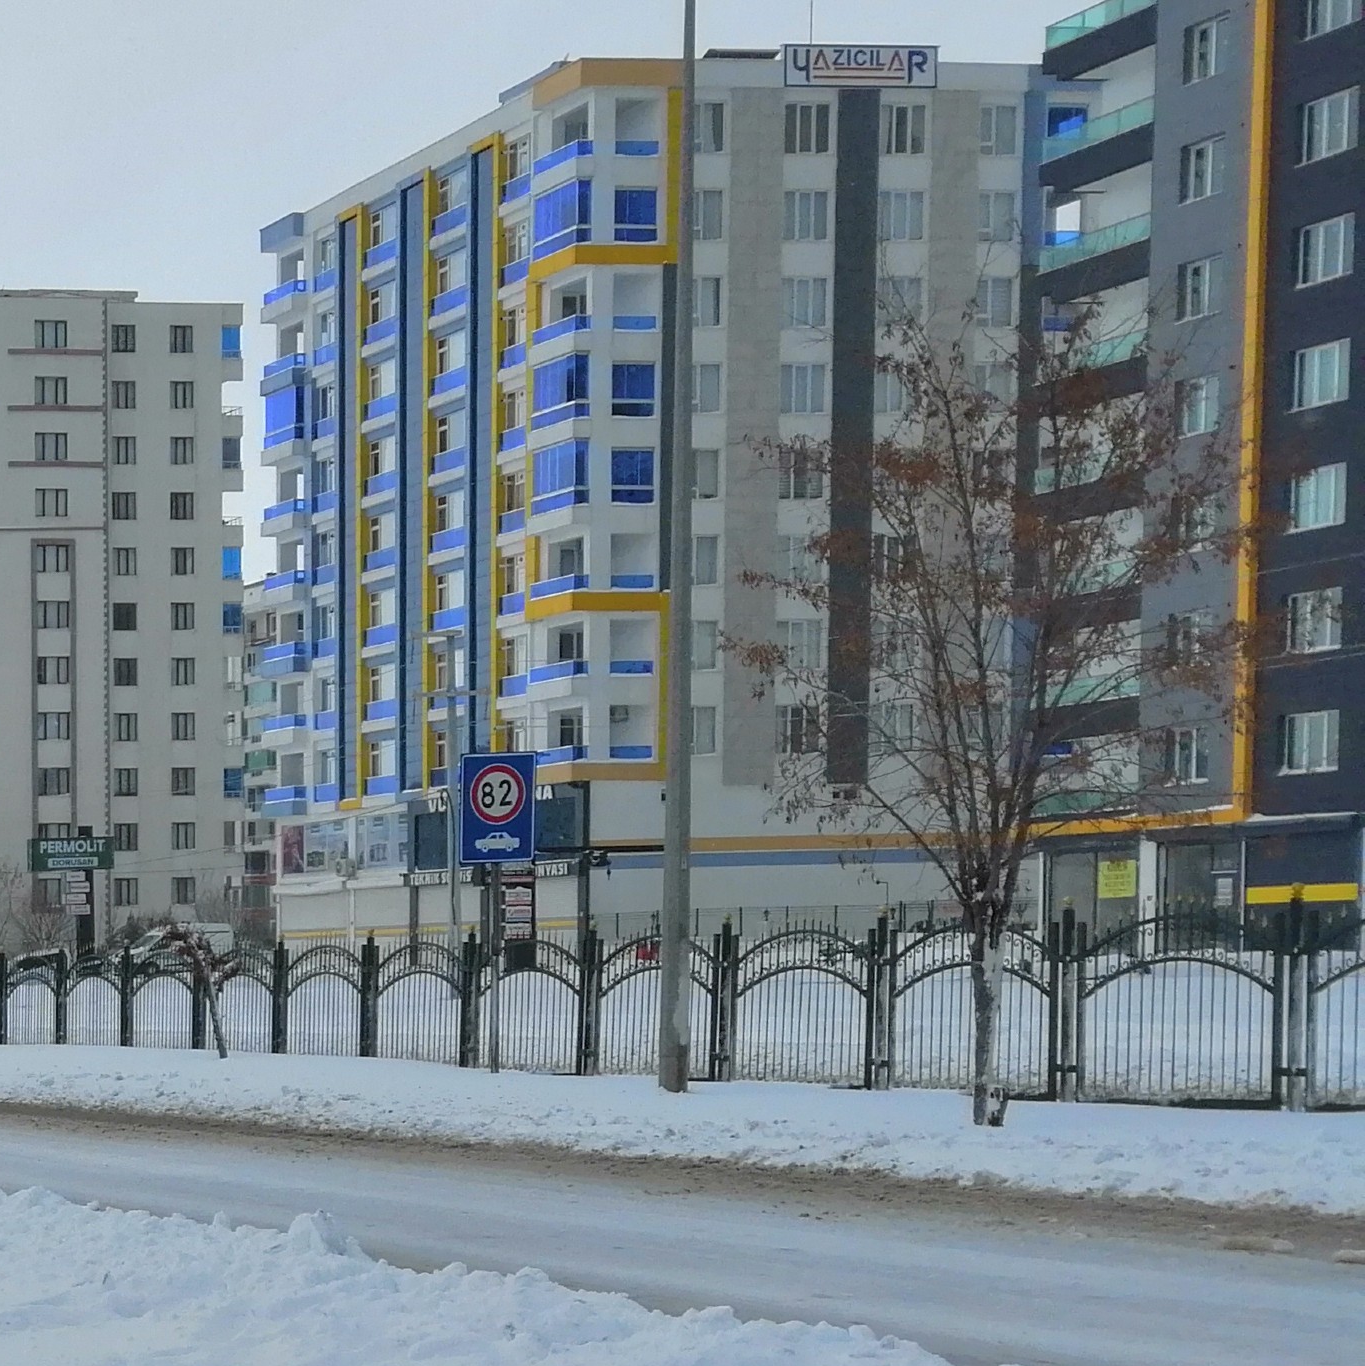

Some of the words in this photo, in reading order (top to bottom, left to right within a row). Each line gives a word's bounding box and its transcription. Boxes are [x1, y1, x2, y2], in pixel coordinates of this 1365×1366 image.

[792, 48, 929, 84] YAZICILAR
[480, 778, 513, 809] 82
[535, 862, 569, 877] NYASI
